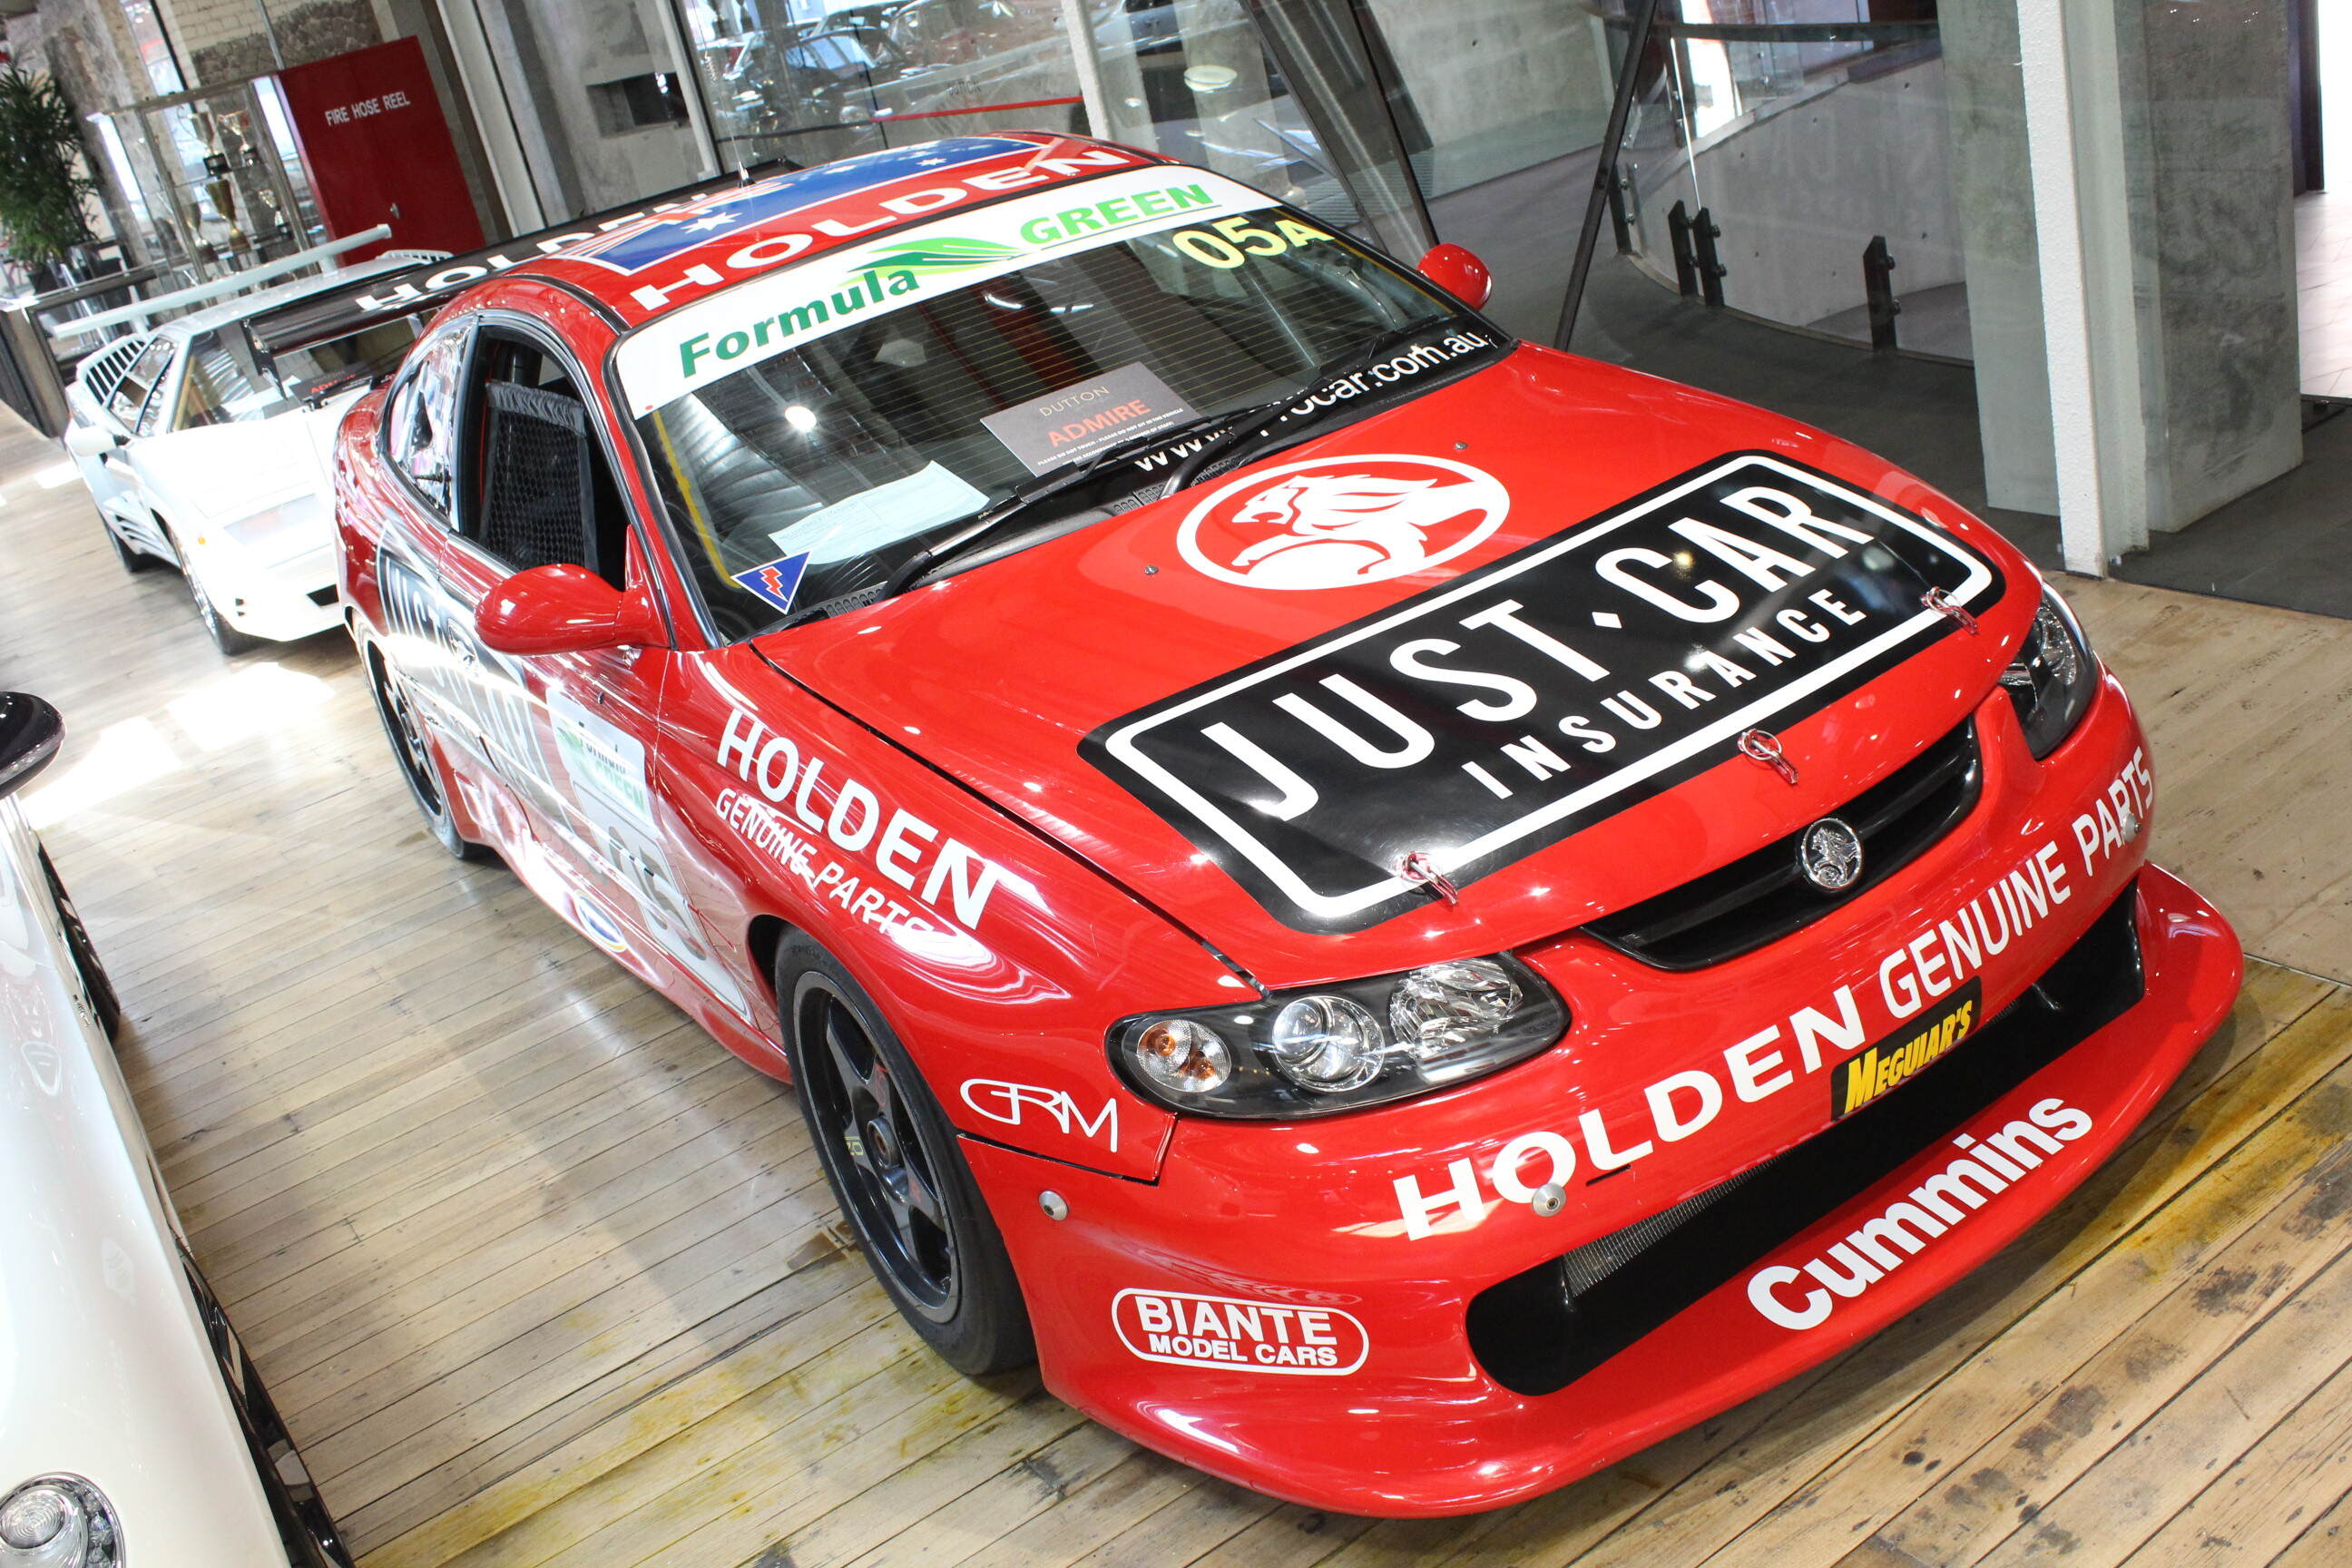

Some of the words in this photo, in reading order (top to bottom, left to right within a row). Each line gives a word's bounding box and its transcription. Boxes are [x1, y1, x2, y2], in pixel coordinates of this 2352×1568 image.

[325, 106, 350, 126] FIRE
[351, 98, 381, 119] HOSE
[382, 91, 411, 111] REEL
[355, 192, 702, 311] HOL
[630, 149, 1131, 312] HOLDEN
[680, 270, 920, 378] Formula
[1020, 184, 1214, 245] GREEN
[1172, 217, 1335, 270] 05A
[1039, 386, 1110, 417] DUTTON
[1048, 399, 1152, 447] ADMIRE
[1200, 599, 1610, 821] JUST
[1594, 485, 1876, 624] CAR
[1462, 588, 1867, 799] INSURANCE
[715, 788, 818, 878] GENUINE
[716, 708, 999, 930] HOLDEN
[1394, 985, 1866, 1241] HOLDEN
[1879, 840, 2072, 1020] GENUINE
[2074, 746, 2155, 877] PARTS
[960, 1077, 1120, 1153] GRM
[1747, 1094, 2093, 1331] Cummins
[1136, 1295, 1338, 1347] BIANTE
[1148, 1334, 1249, 1365] MODEL
[1256, 1341, 1338, 1367] CARS
